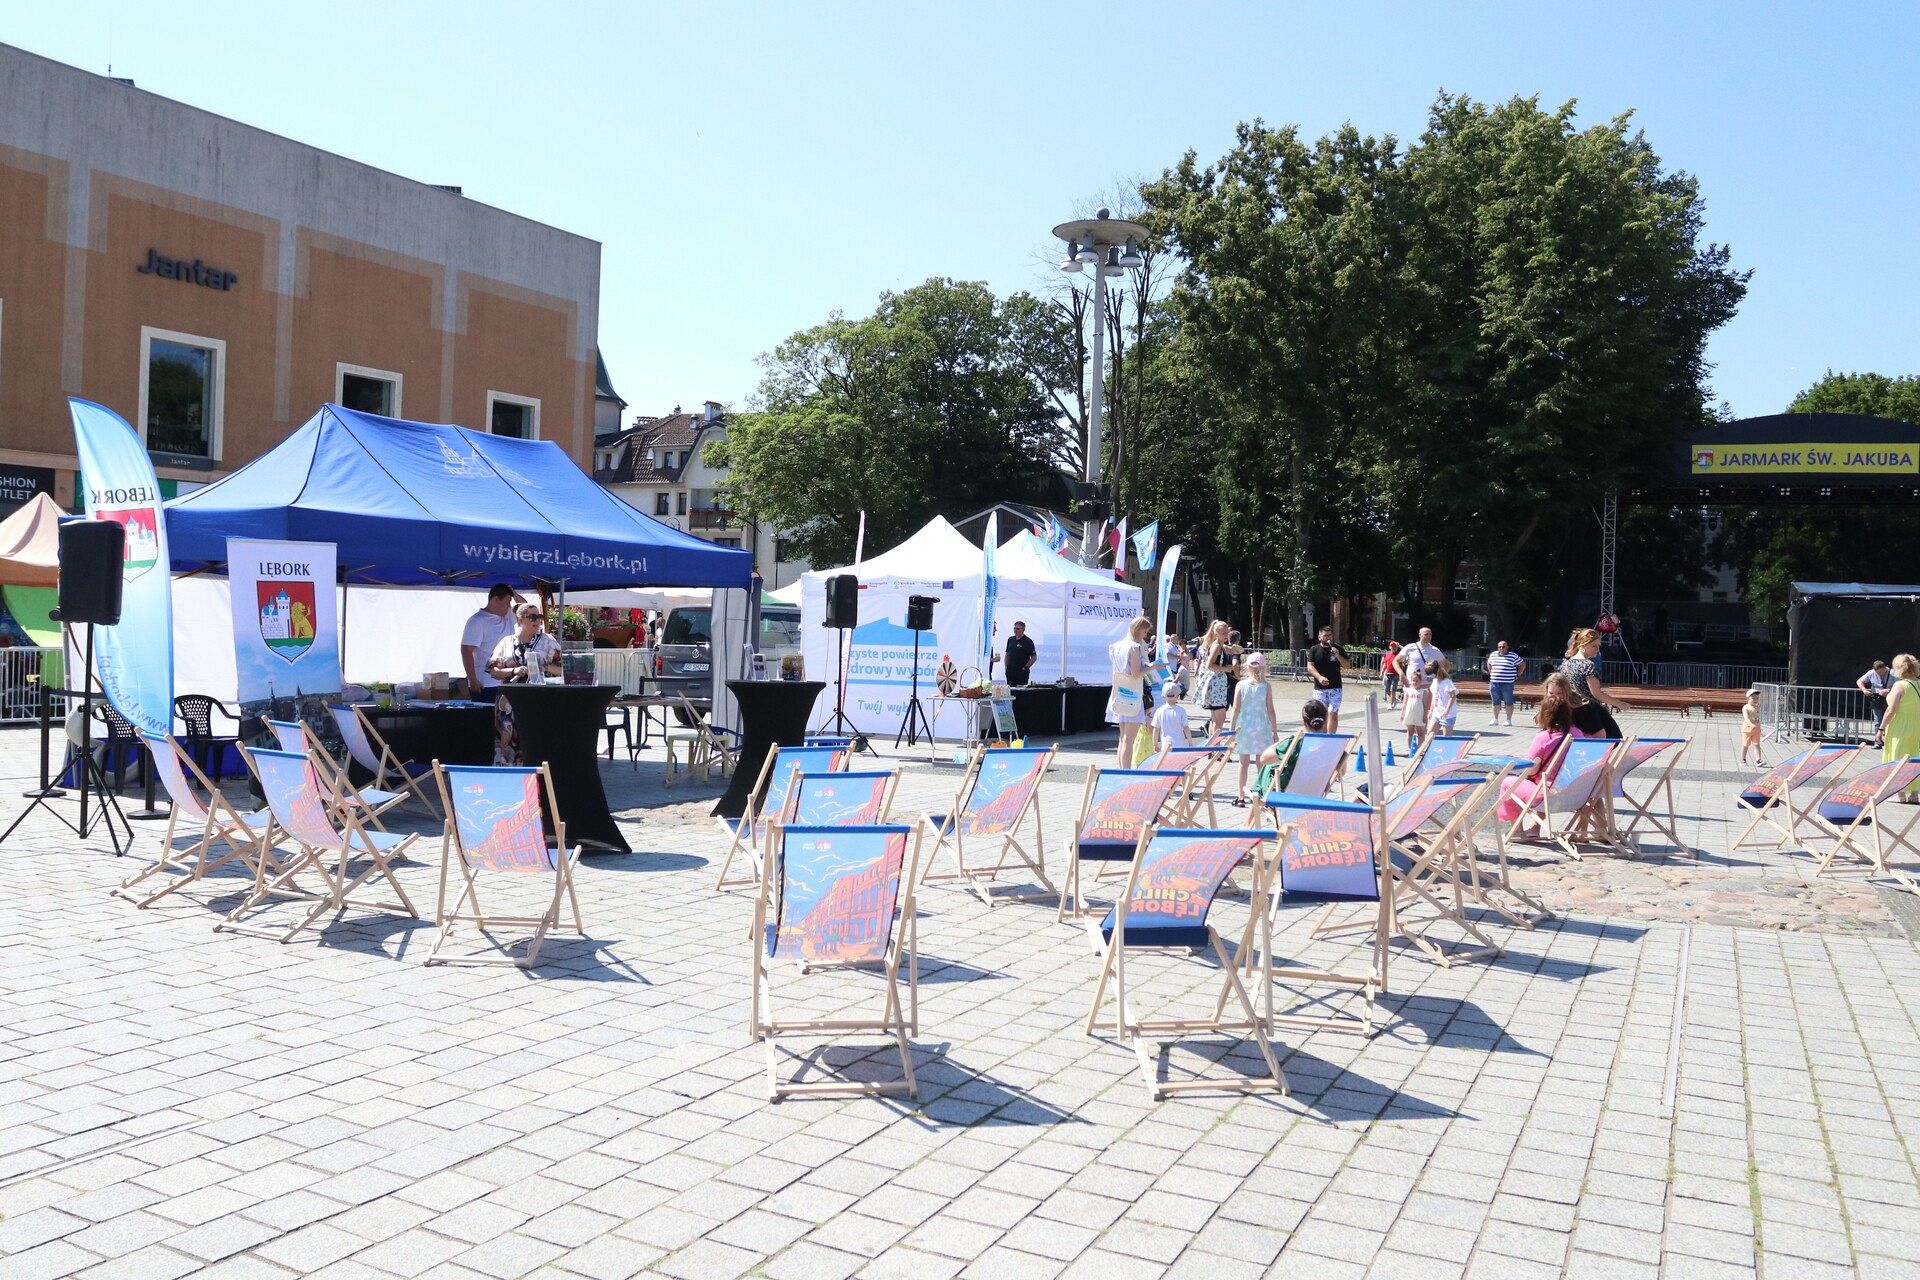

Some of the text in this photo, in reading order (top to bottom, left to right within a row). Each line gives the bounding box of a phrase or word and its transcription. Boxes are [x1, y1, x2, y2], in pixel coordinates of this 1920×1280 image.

[137, 248, 238, 291] Jantar
[1720, 449, 1913, 466] JARMARK ŚW. JAKUBA
[462, 543, 648, 575] wybierzLębork.pl
[259, 562, 311, 577] LĘBORK
[847, 662, 893, 678] drowy
[858, 700, 883, 715] Twój
